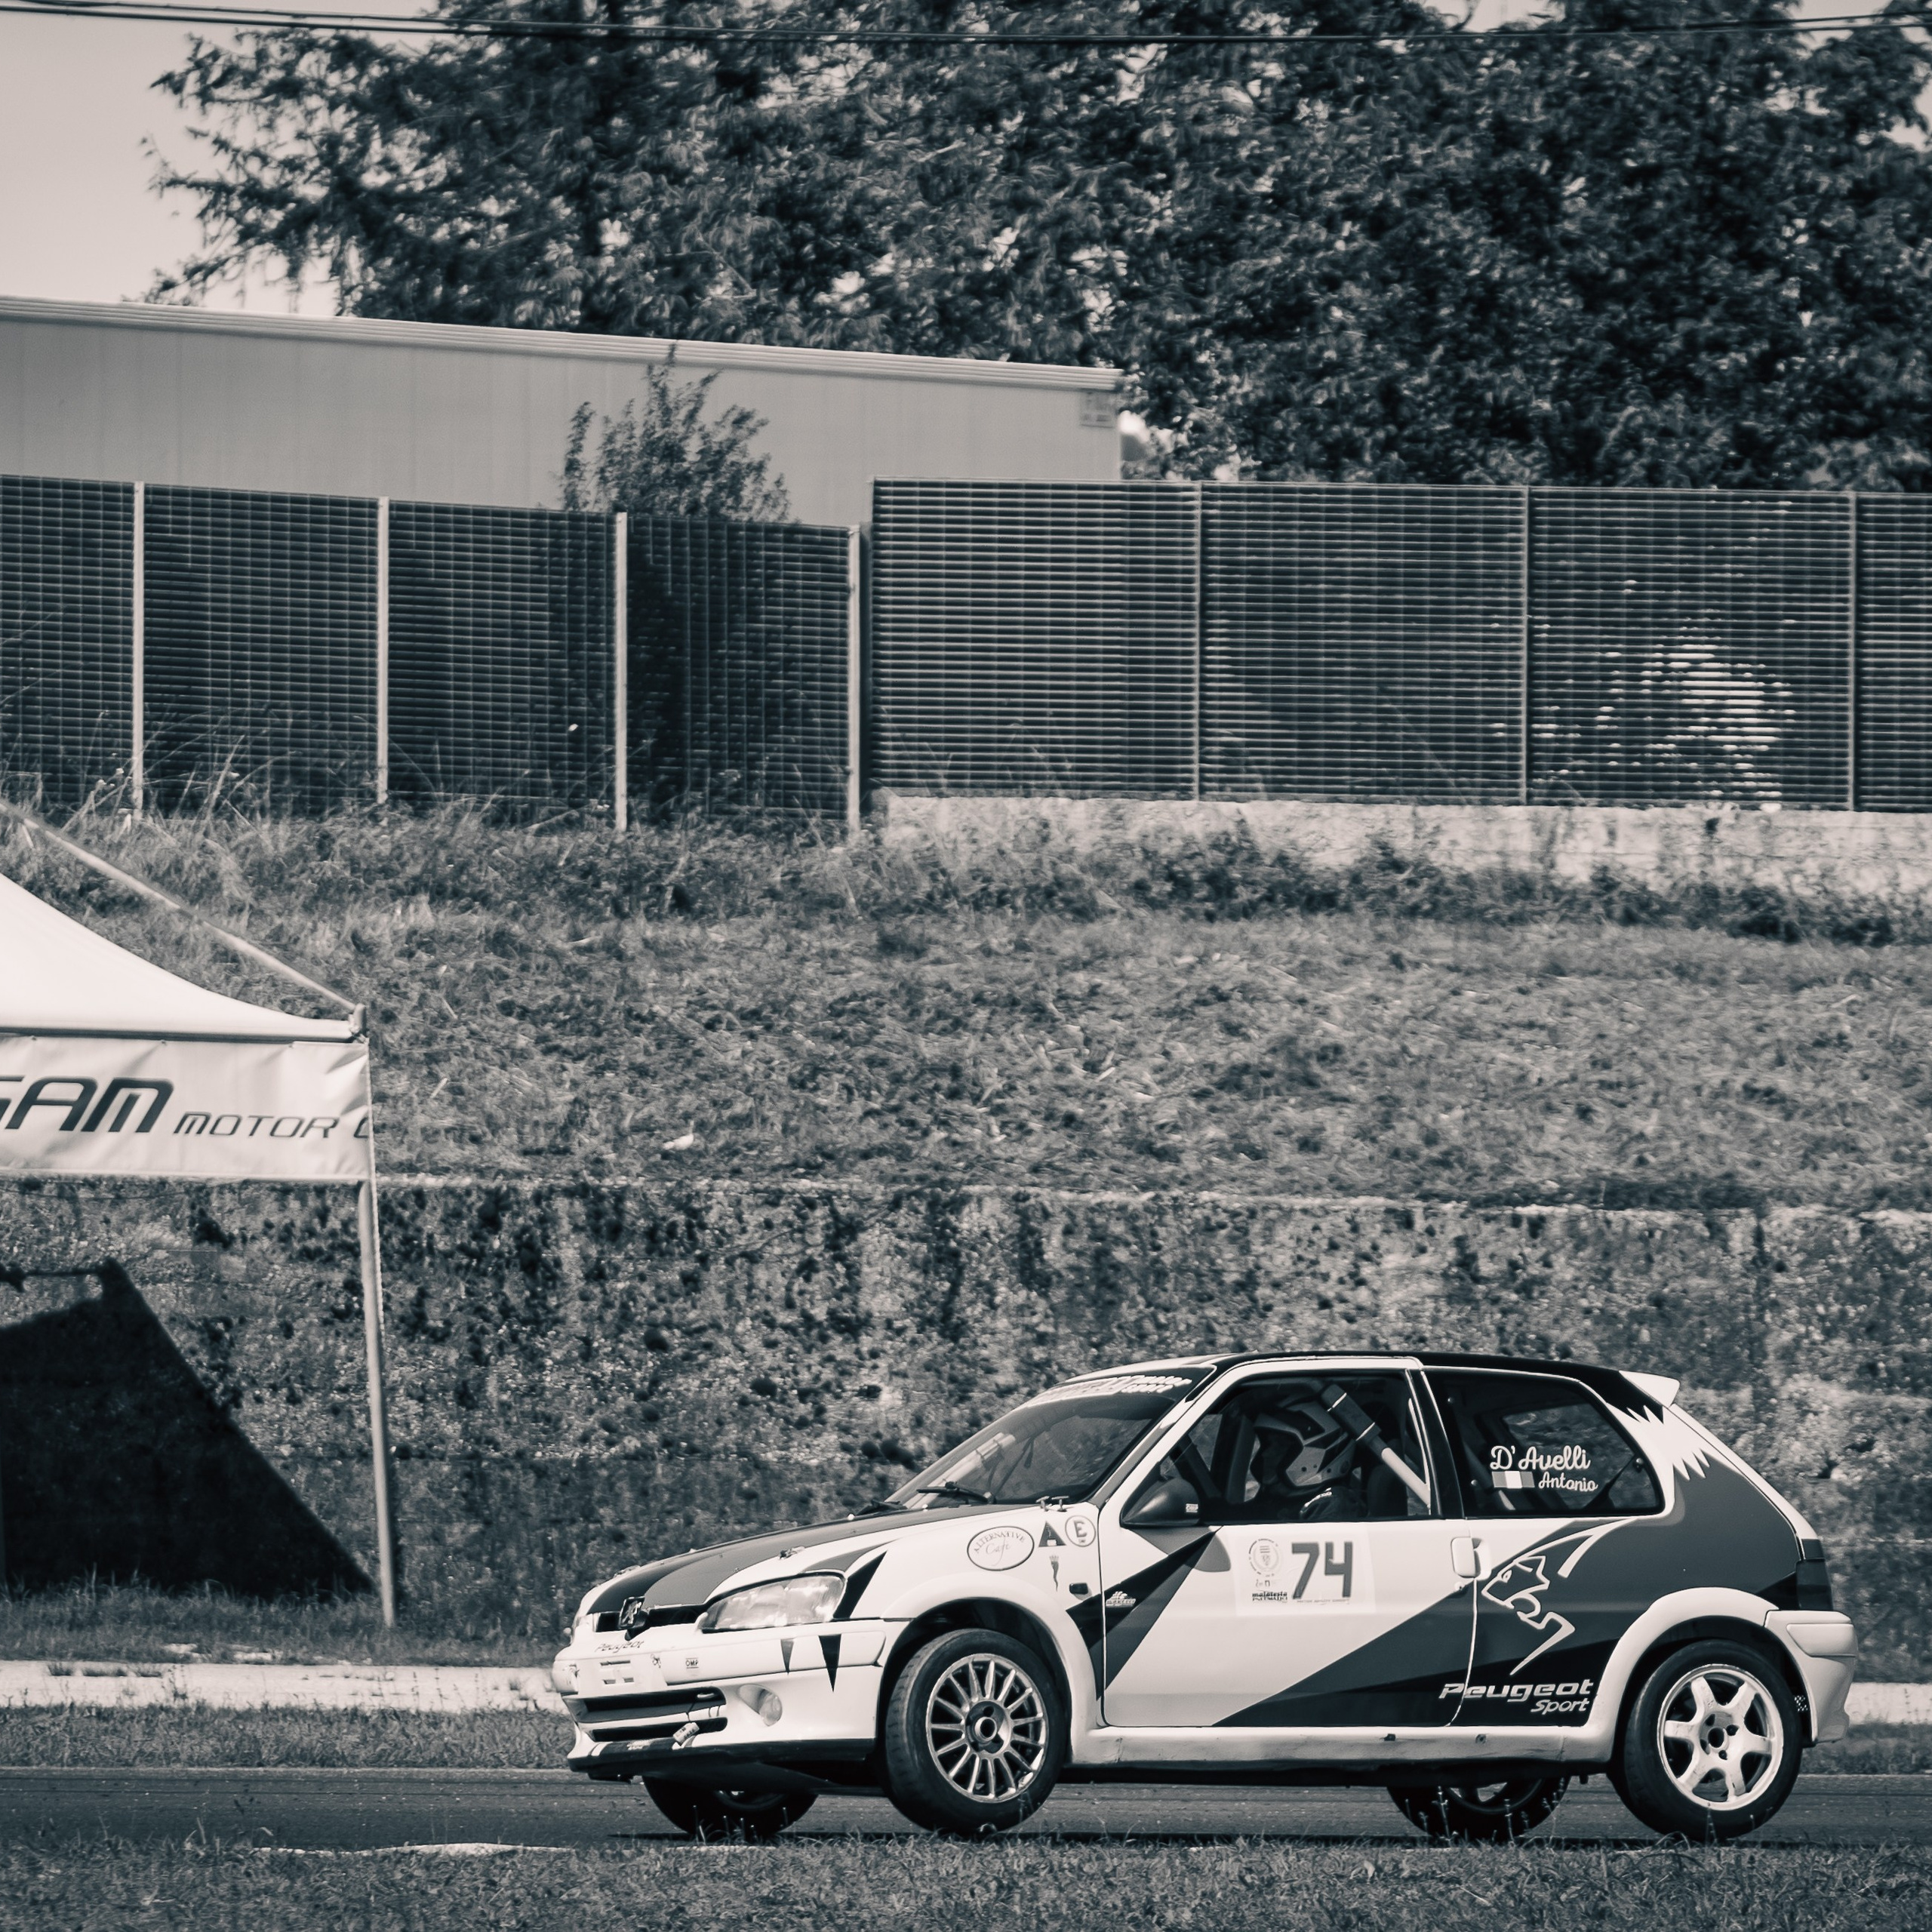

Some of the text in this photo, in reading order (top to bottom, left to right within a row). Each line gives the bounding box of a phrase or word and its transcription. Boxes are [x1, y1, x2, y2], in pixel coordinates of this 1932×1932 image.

[173, 1111, 340, 1139] MOTOR
[1538, 1472, 1599, 1492] Antonio
[1074, 1520, 1088, 1538] E
[1291, 1541, 1353, 1600] 74
[1438, 1678, 1594, 1703] Peugeot
[1530, 1697, 1589, 1715] Sport
